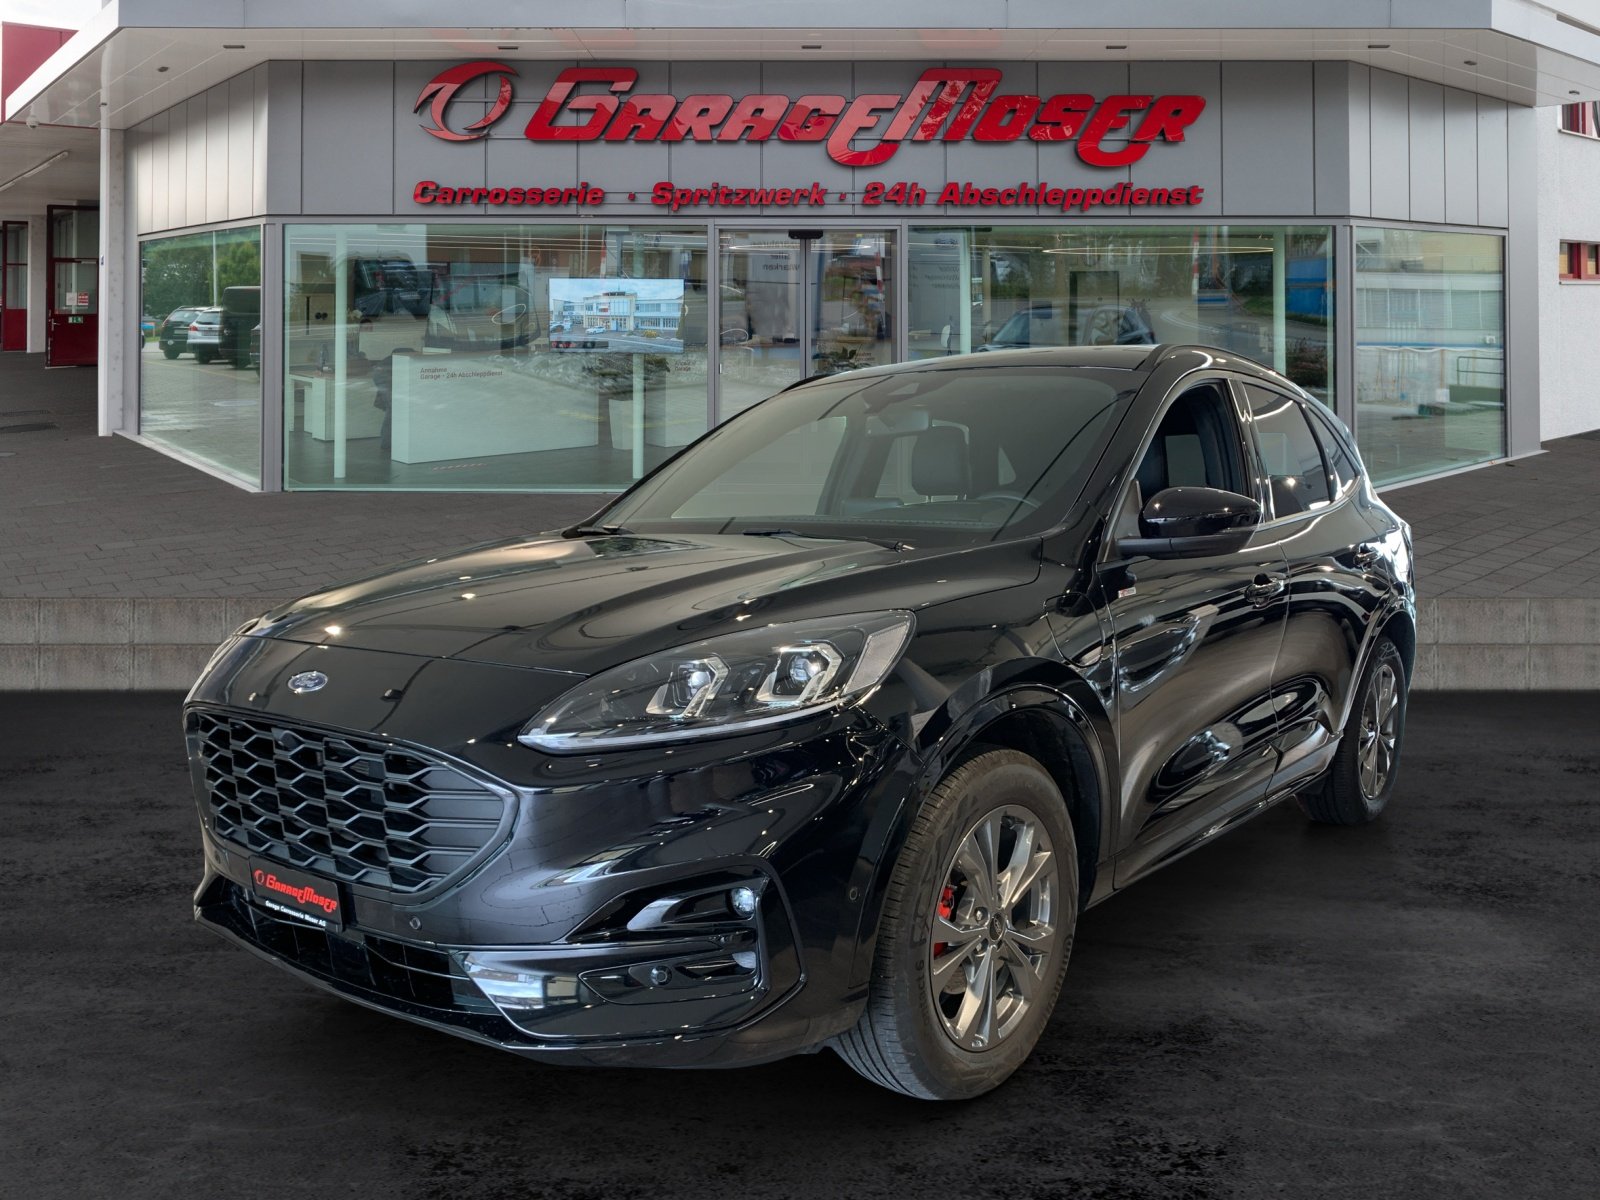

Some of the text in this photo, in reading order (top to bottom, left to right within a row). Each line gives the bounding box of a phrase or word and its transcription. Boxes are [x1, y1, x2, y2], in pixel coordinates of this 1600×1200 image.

[413, 181, 1204, 211] Carrosserie Spritzwerk 24h Abschleppdienst
